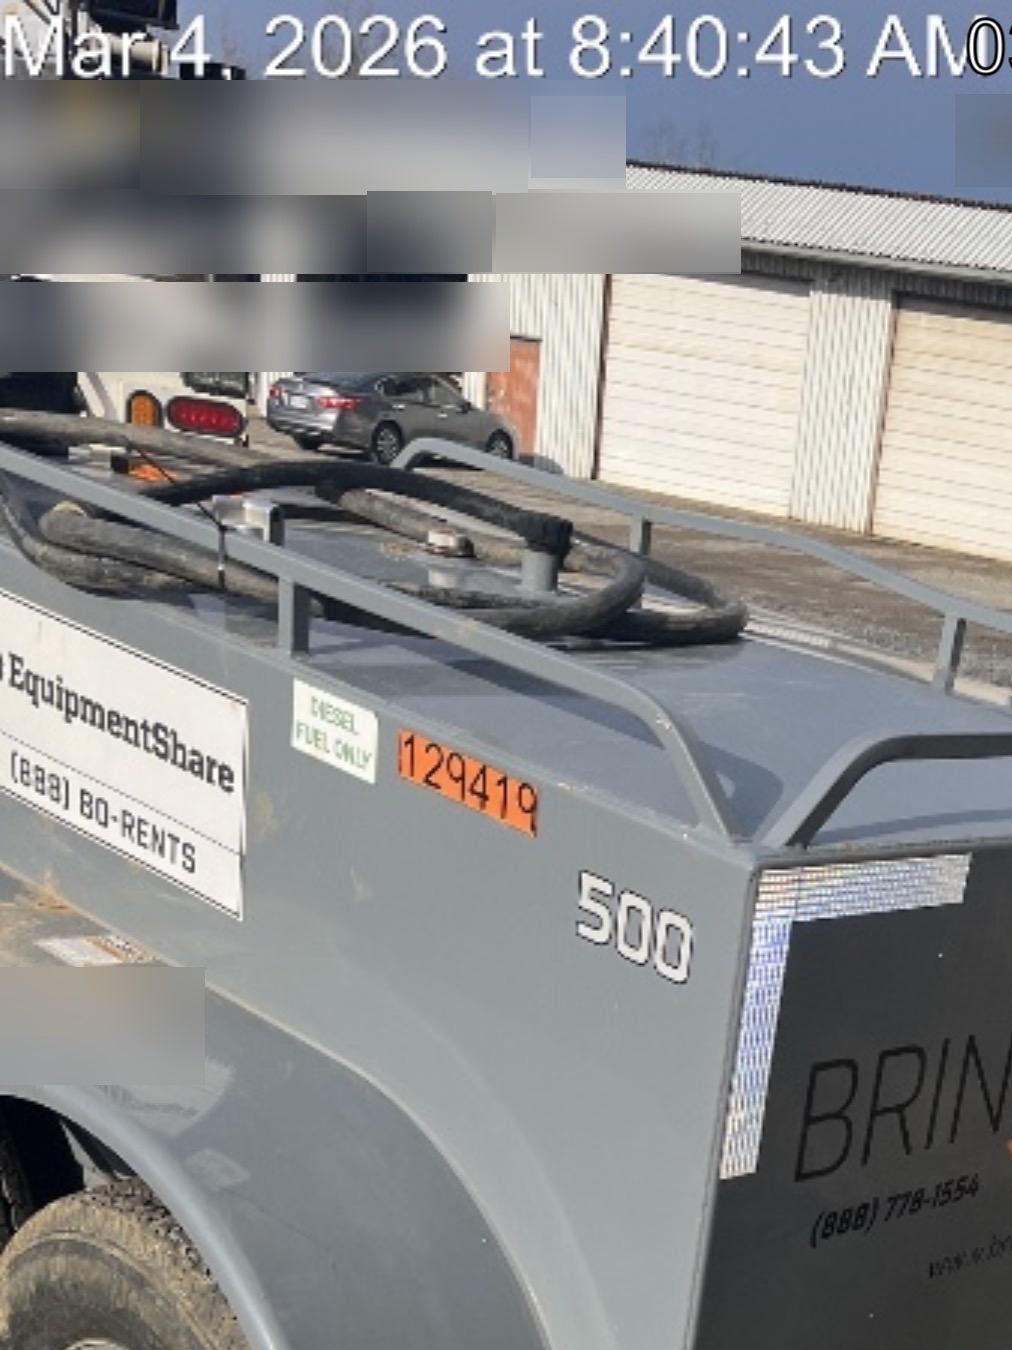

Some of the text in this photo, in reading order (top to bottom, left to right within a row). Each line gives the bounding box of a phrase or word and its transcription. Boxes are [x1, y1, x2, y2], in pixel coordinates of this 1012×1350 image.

[9, 651, 235, 793] EquipmentShare
[296, 721, 374, 770] FUEL ONLY
[310, 696, 360, 736] DIESEL
[10, 752, 70, 811] (888)
[403, 733, 538, 832] 129419
[576, 869, 693, 985] 500
[810, 1196, 879, 1249] (888)
